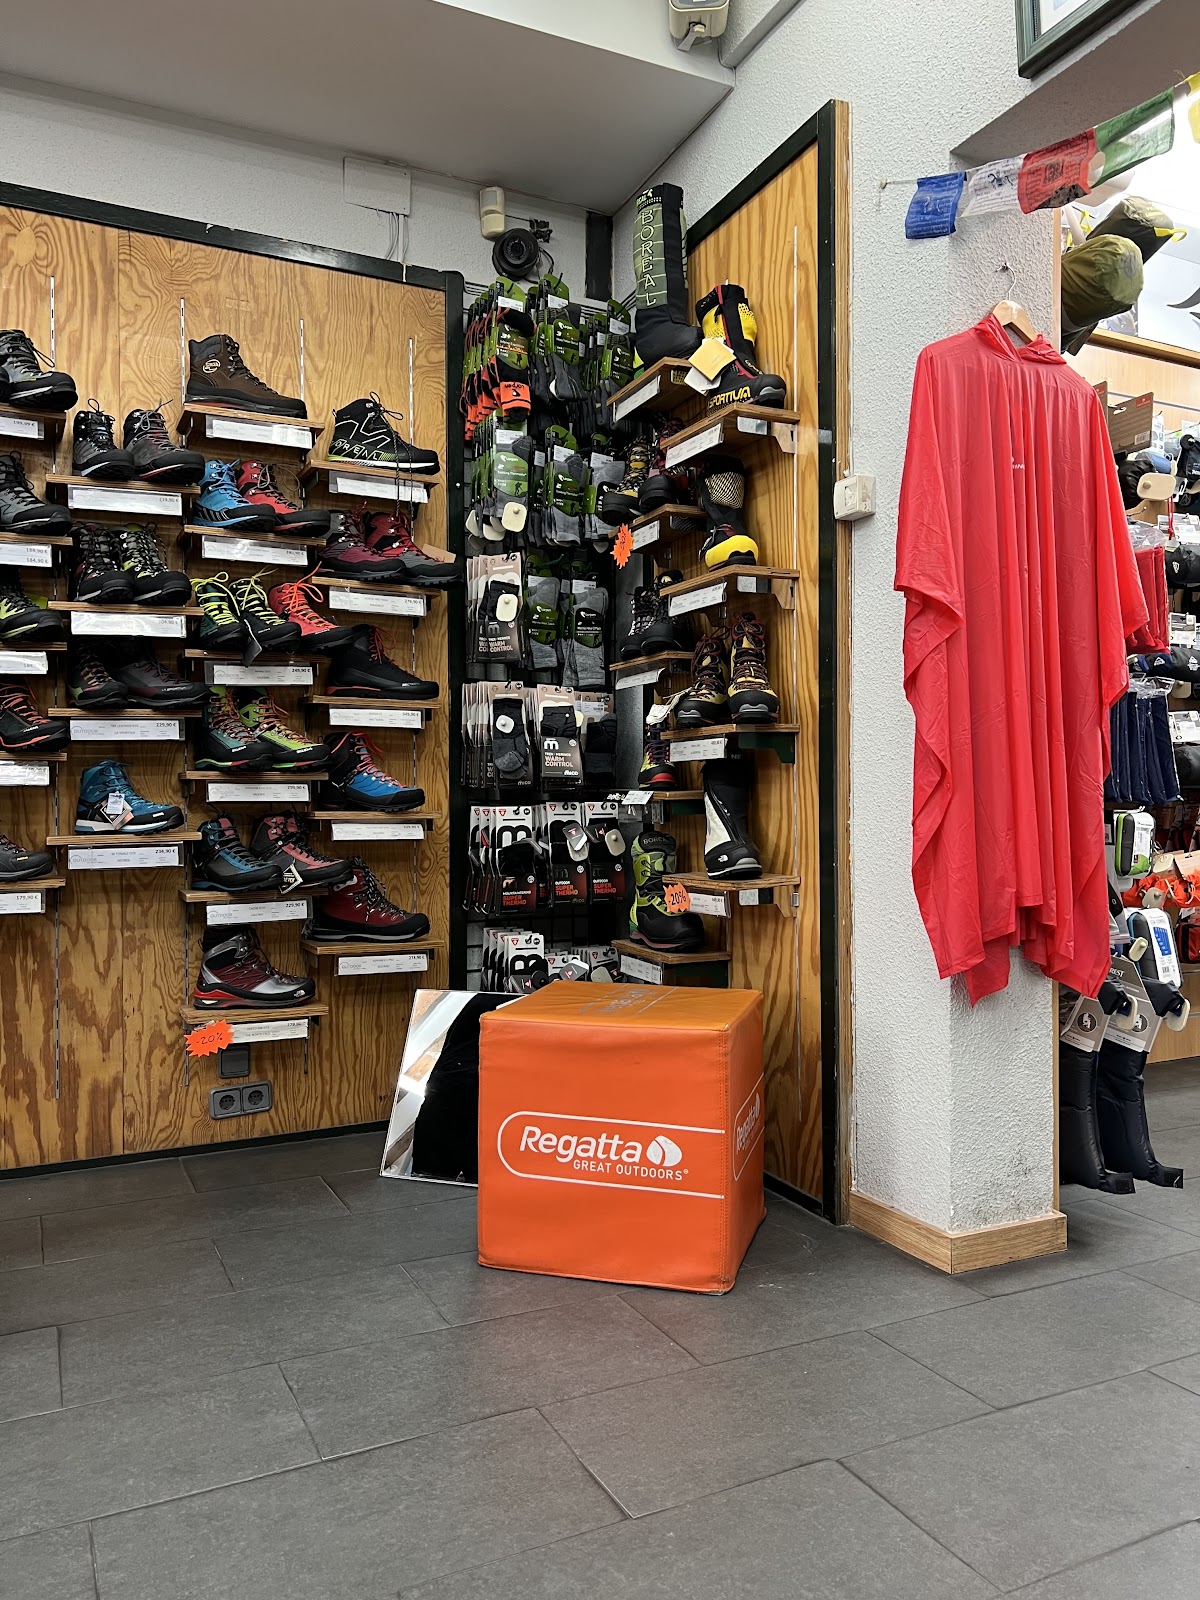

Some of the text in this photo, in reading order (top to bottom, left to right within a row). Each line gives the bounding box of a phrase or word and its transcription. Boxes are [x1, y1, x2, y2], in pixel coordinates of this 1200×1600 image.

[640, 209, 657, 306] BOREAL
[490, 645, 514, 653] CONTROL
[196, 1032, 223, 1046] -20%
[519, 1125, 643, 1163] Regatta
[573, 1159, 611, 1173] GREAT
